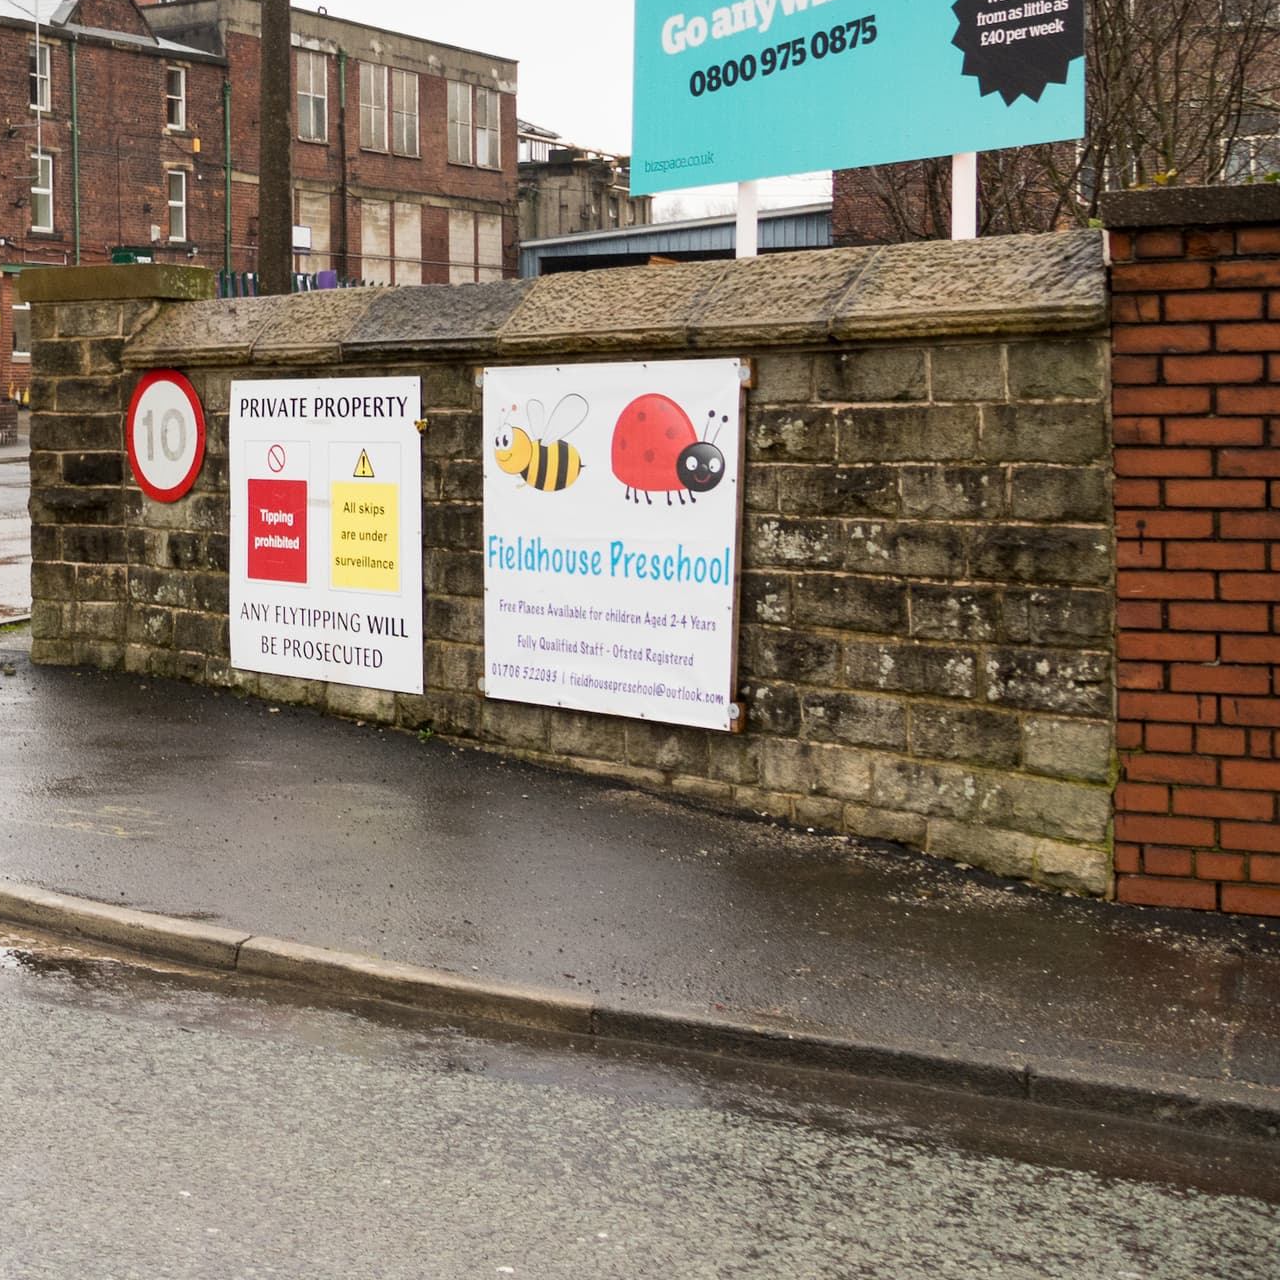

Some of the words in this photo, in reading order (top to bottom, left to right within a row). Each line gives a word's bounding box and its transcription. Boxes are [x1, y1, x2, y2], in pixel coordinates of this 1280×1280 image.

[976, 10, 1007, 26] from
[1007, 7, 1023, 20] as
[1023, 0, 1053, 18] little
[661, 13, 707, 56] Go
[980, 30, 1004, 47] £40
[1005, 27, 1028, 45] per
[1028, 18, 1065, 38] week
[689, 52, 757, 97] 0800
[760, 38, 807, 77] 975
[810, 14, 878, 60] 0875
[644, 150, 715, 174] bizspace.co.uk
[240, 397, 308, 418] PRIVATE
[313, 396, 409, 418] PROPERTY
[141, 407, 187, 462] 10
[260, 508, 294, 526] Tipping
[343, 502, 356, 513] All
[358, 503, 385, 517] skips
[254, 534, 300, 551] prohibited
[341, 530, 356, 541] are
[359, 530, 388, 542] under
[335, 556, 394, 570] surveillance
[488, 534, 602, 576] Fieldhouse
[610, 540, 730, 586] Preschool
[240, 602, 270, 621] ANY
[274, 604, 361, 633] FLYTIPPING
[366, 615, 409, 639] WILL
[499, 599, 517, 613] Free
[518, 600, 545, 616] Places
[547, 603, 587, 620] Available
[588, 606, 602, 622] for
[605, 608, 642, 625] children
[644, 611, 667, 628] Aged
[670, 613, 688, 629] 2-4
[690, 615, 717, 632] Years
[260, 635, 278, 656] BE
[283, 637, 383, 669] PROSECUTED
[517, 634, 537, 652] Fully
[539, 636, 578, 654] Qualified
[579, 640, 604, 657] Staff
[612, 644, 643, 662] Ofsted
[645, 647, 694, 667] Registered
[491, 662, 521, 679] 01706
[569, 671, 724, 705] fieldhousepreschool@outlook.com
